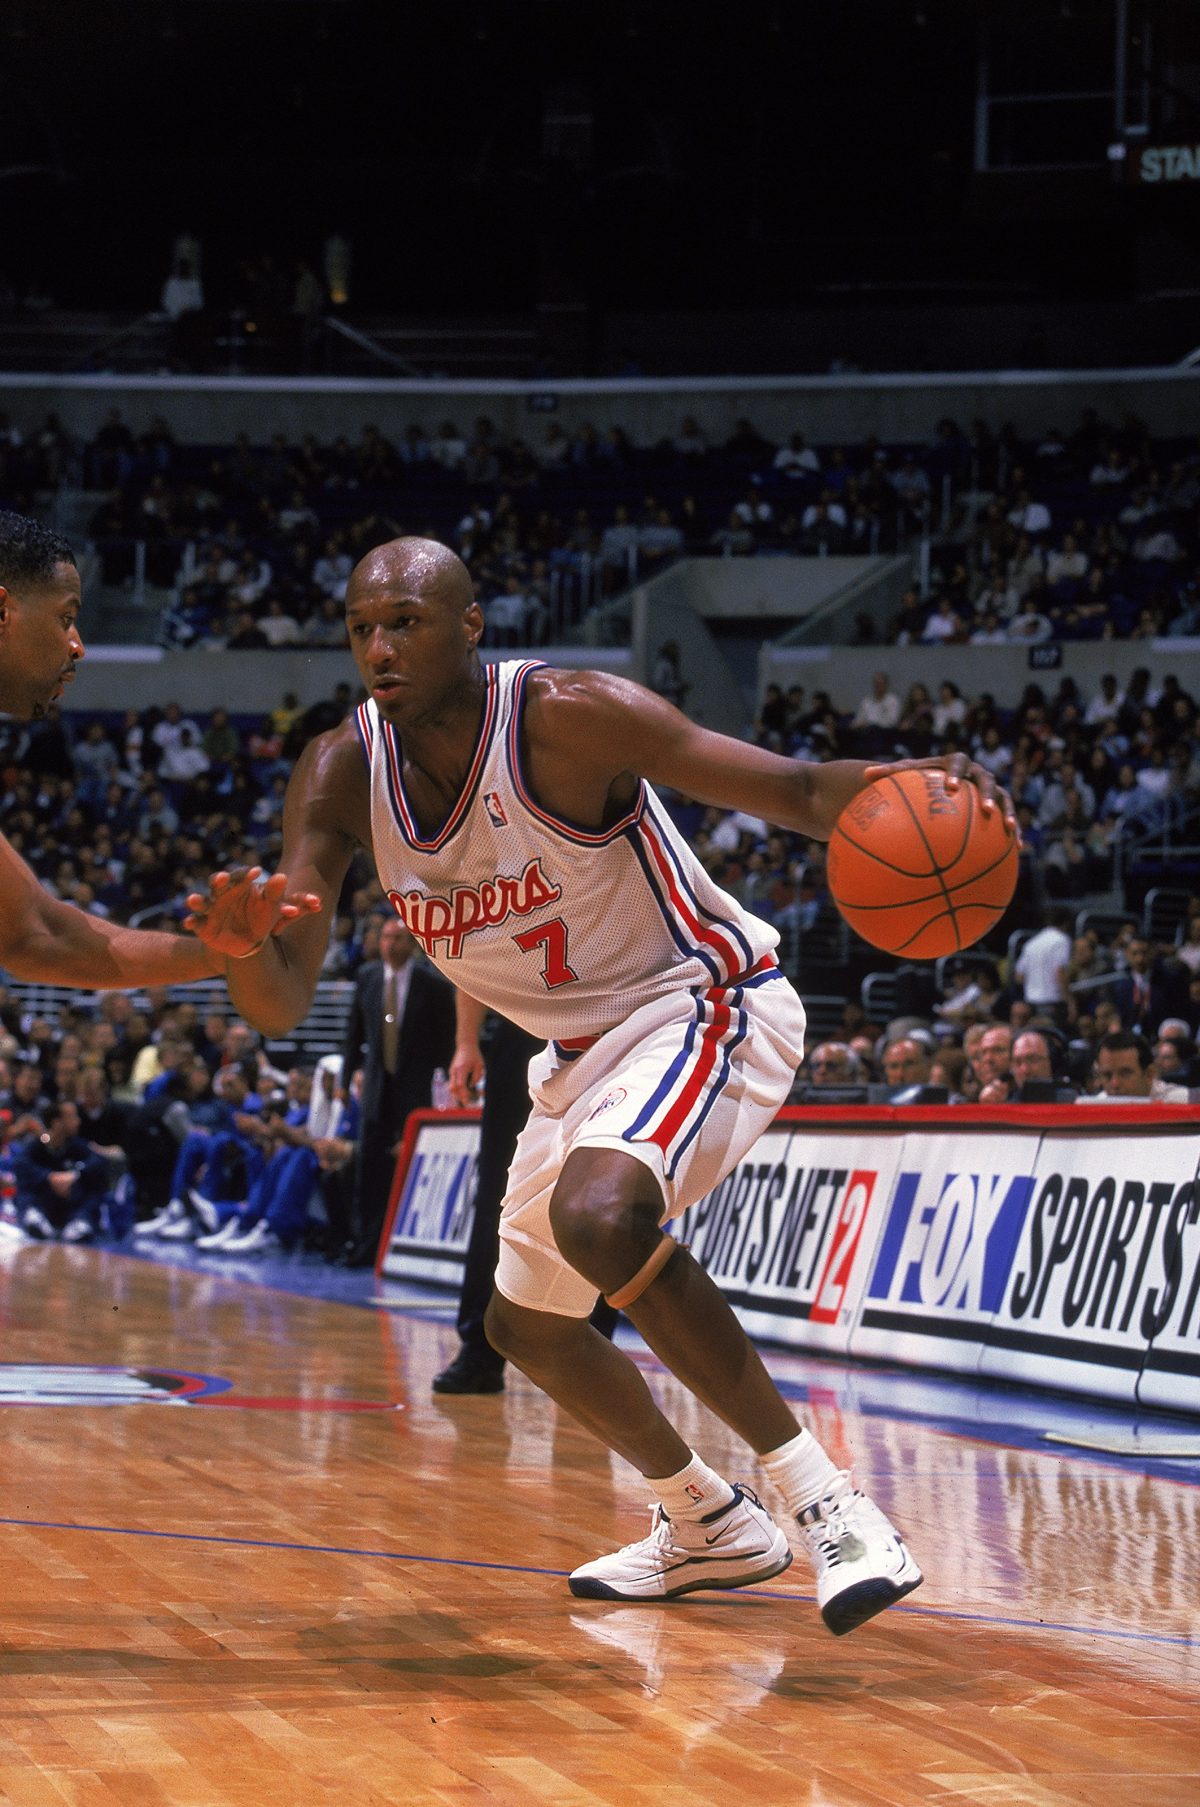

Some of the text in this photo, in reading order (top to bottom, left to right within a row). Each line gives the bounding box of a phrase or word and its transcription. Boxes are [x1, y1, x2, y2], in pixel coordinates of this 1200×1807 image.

[1141, 146, 1200, 182] STA
[386, 857, 562, 960] lippers
[512, 917, 578, 991] 7
[882, 1172, 1022, 1312] FOX
